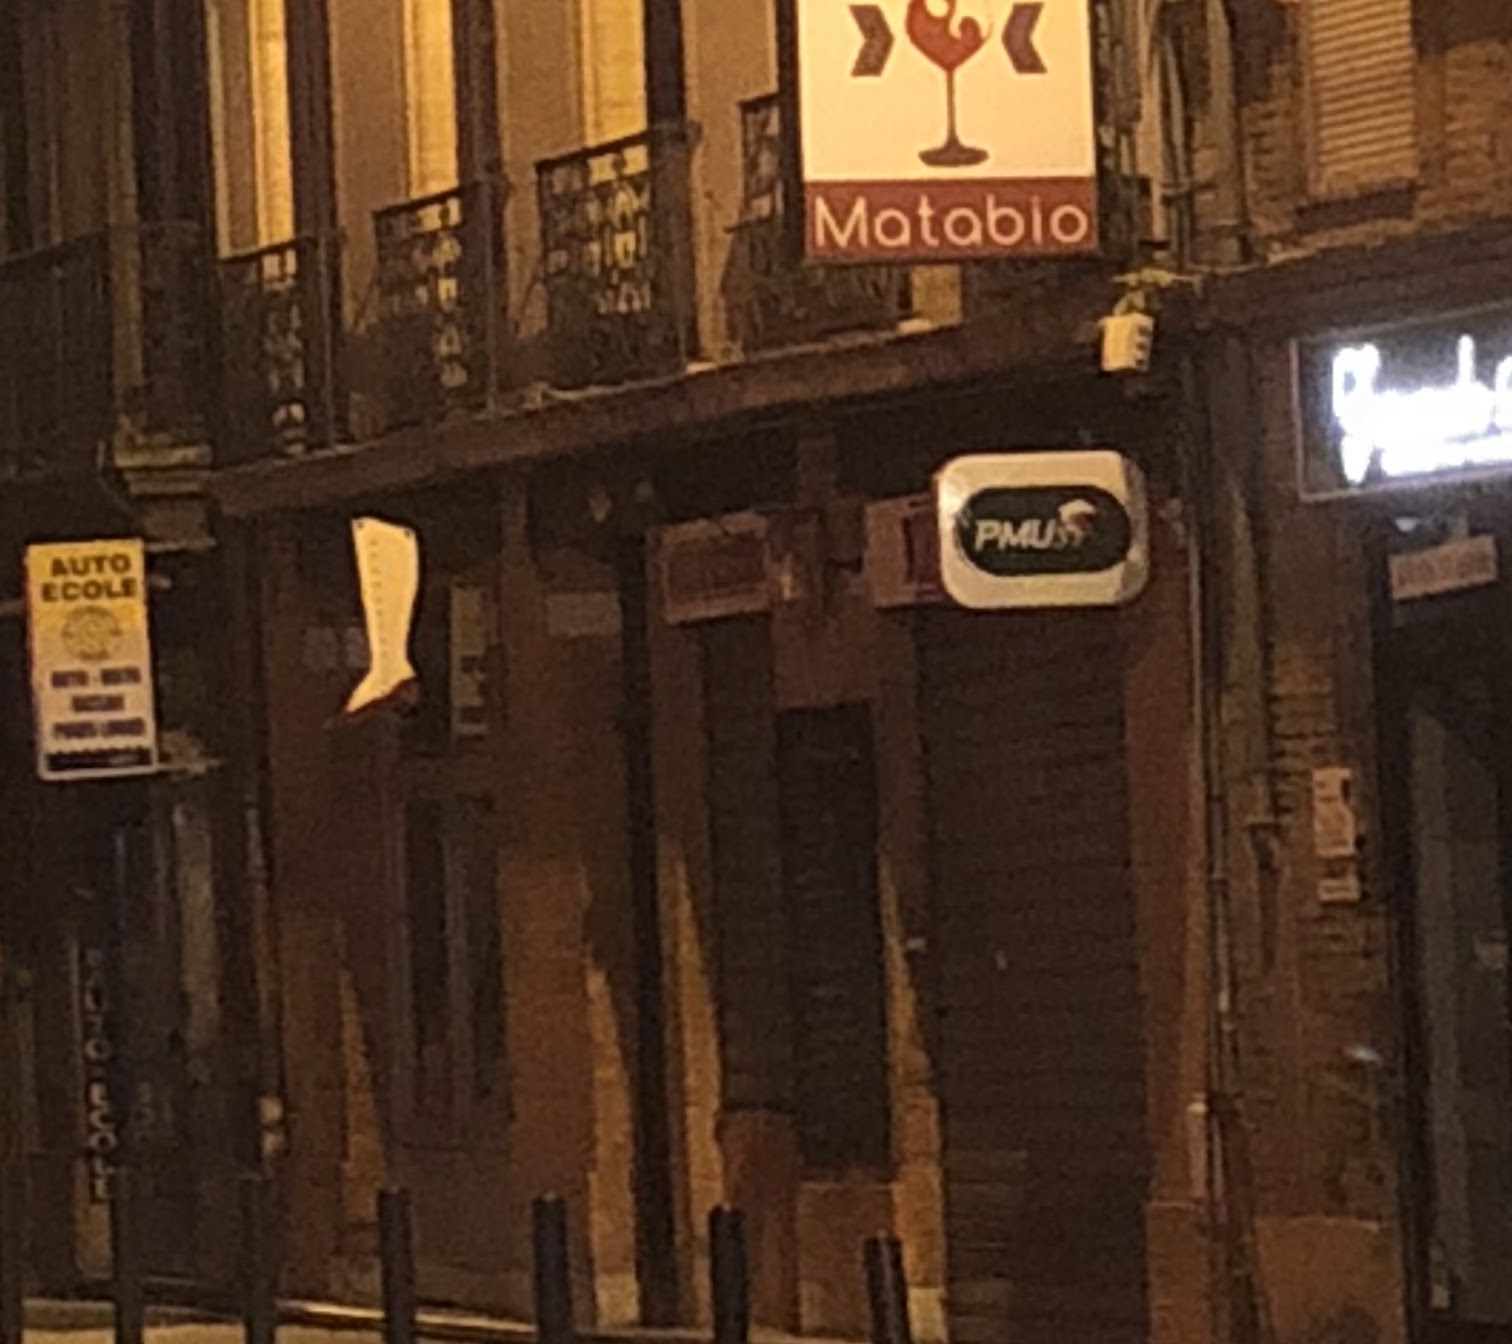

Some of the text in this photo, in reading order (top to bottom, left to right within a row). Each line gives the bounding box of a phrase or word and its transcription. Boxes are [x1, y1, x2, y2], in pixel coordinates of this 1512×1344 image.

[814, 194, 1088, 248] Matabio
[974, 518, 1057, 552] PMU
[50, 553, 132, 577] AUTO
[40, 577, 137, 603] ECOLE
